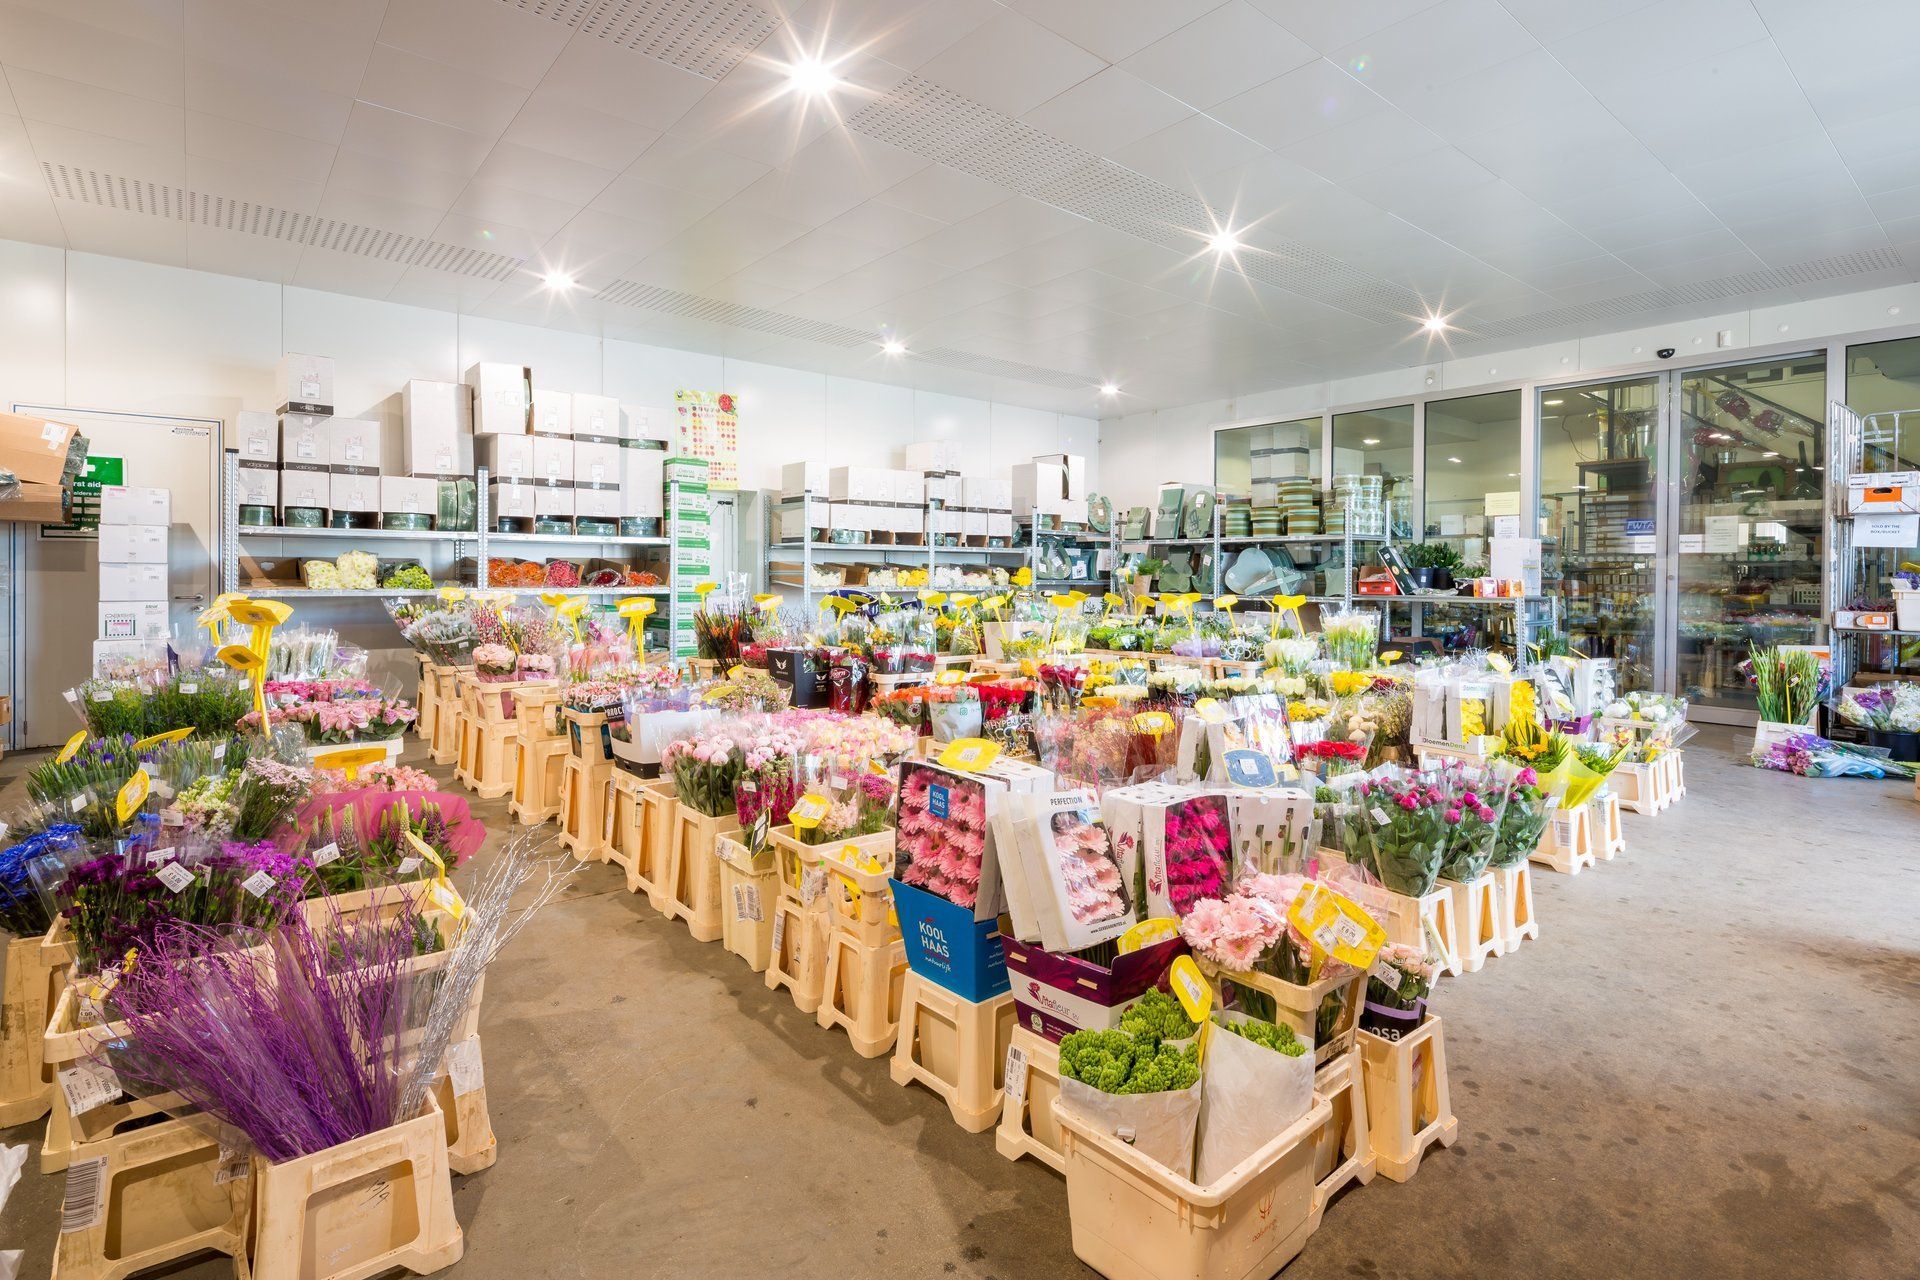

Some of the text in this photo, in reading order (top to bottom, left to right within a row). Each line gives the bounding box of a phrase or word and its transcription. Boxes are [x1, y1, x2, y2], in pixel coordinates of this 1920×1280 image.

[932, 791, 945, 801] KOOL
[1050, 796, 1083, 806] PERFECTION
[932, 798, 946, 809] HAAS
[918, 921, 948, 944] KOOL
[921, 935, 950, 958] HAAS
[1371, 1027, 1400, 1041] osa
